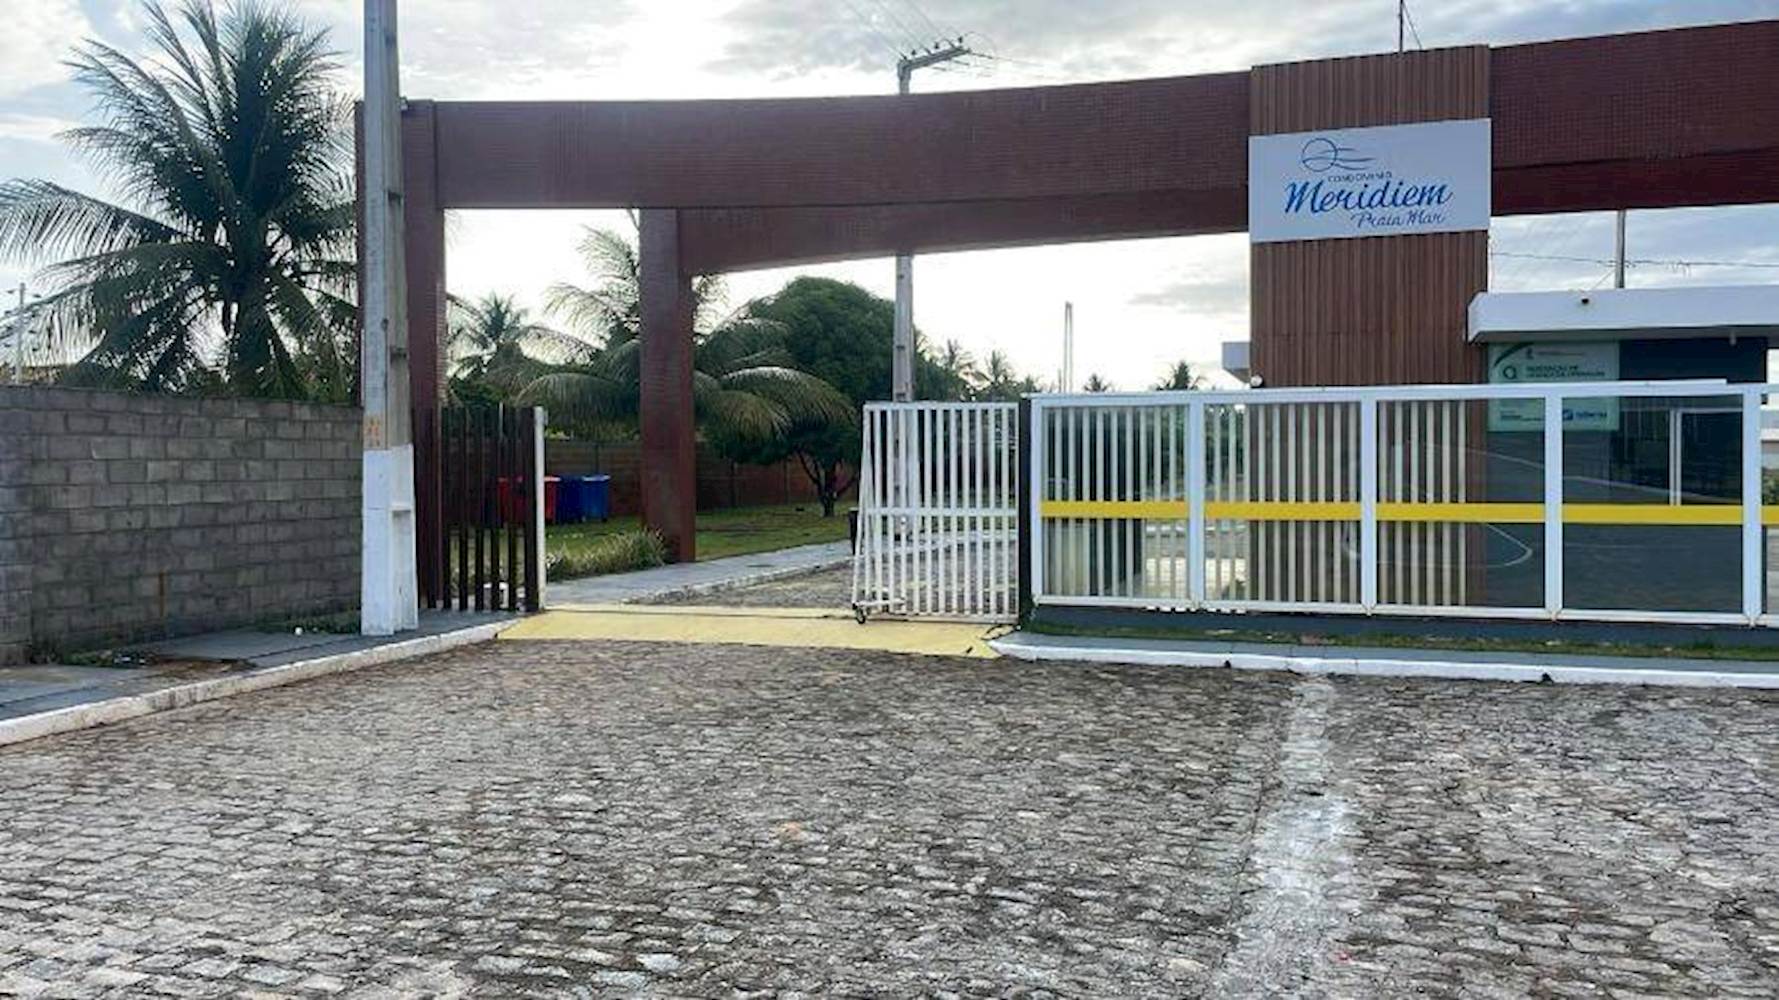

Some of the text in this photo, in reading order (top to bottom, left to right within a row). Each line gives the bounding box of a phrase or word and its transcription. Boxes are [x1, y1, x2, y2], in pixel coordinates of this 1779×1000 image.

[1284, 180, 1453, 214] Meridiem
[1351, 209, 1447, 228] Praia Mar
